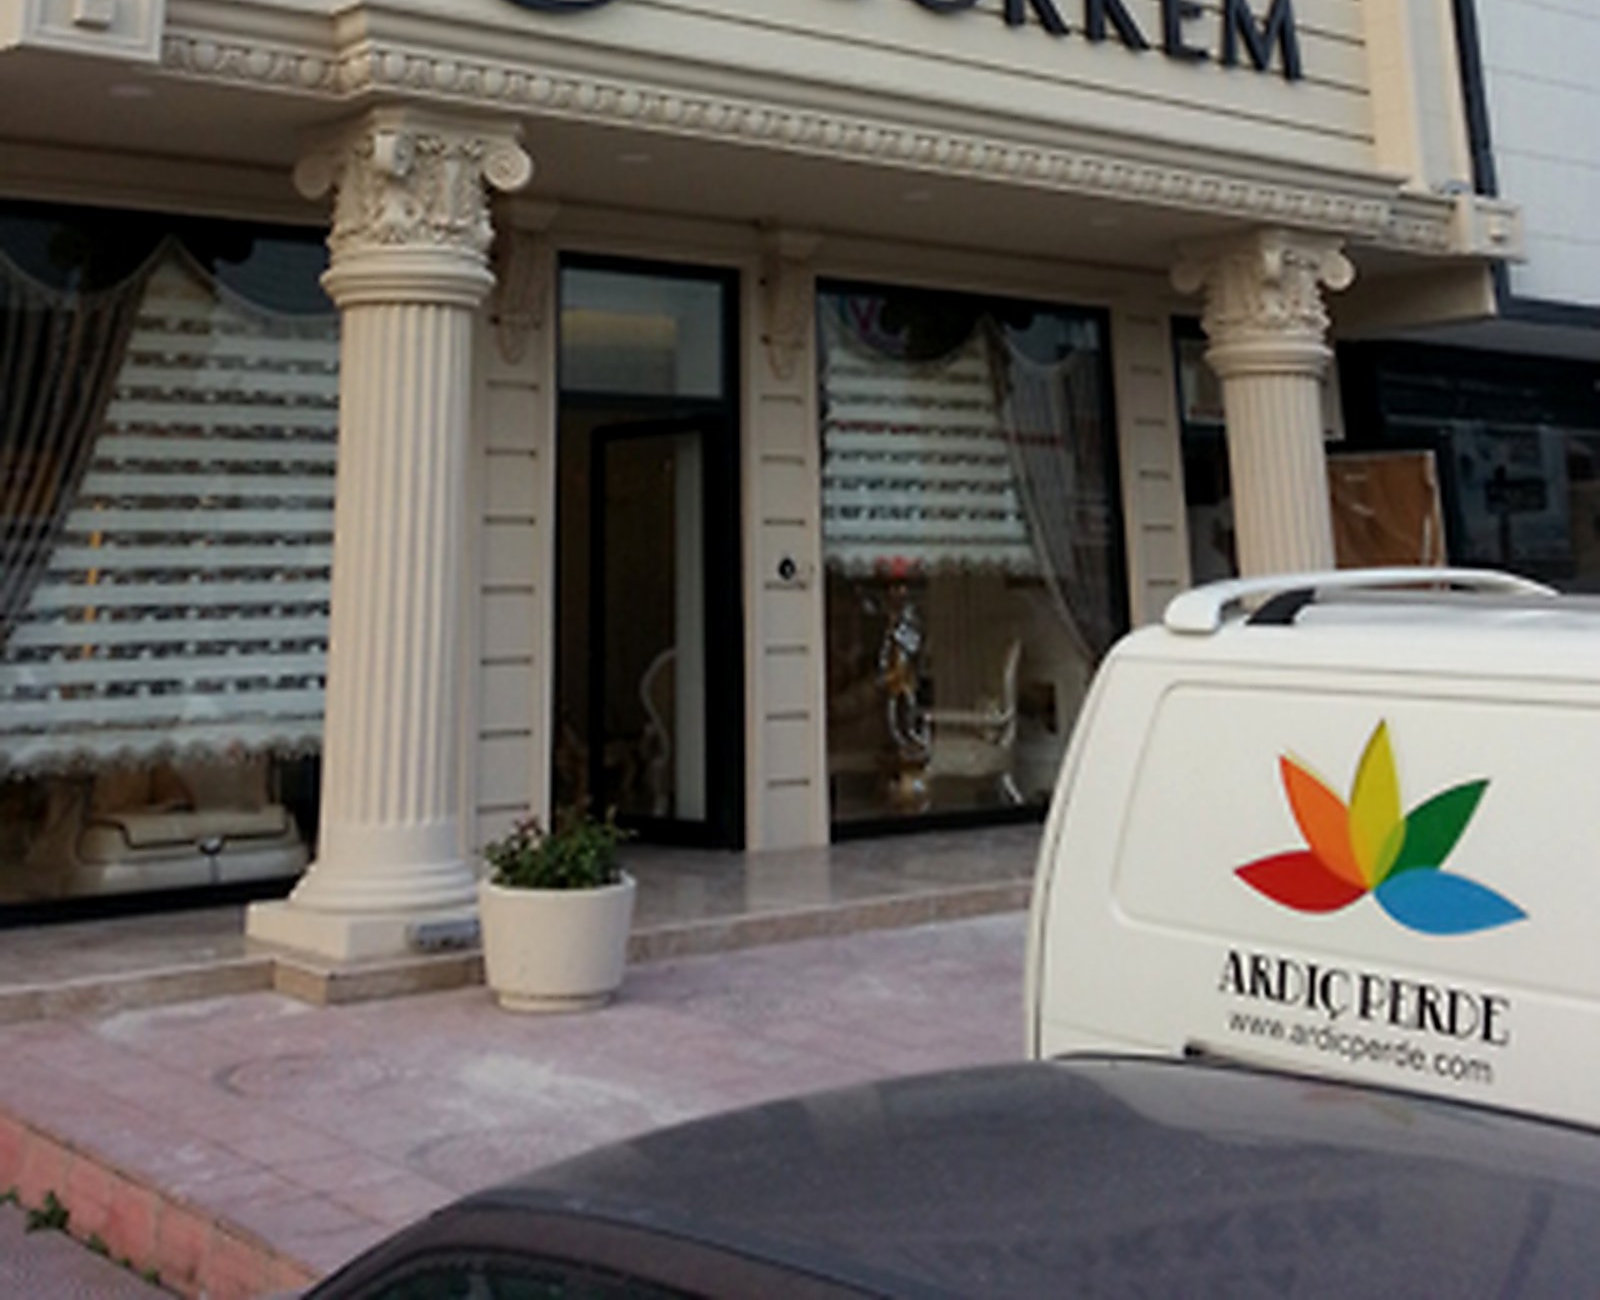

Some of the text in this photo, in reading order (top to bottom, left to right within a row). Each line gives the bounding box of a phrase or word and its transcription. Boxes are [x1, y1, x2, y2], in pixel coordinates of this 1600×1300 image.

[1218, 950, 1511, 1046] ARDIÇ PERDE
[1228, 1011, 1494, 1083] www.ardicperde.com
